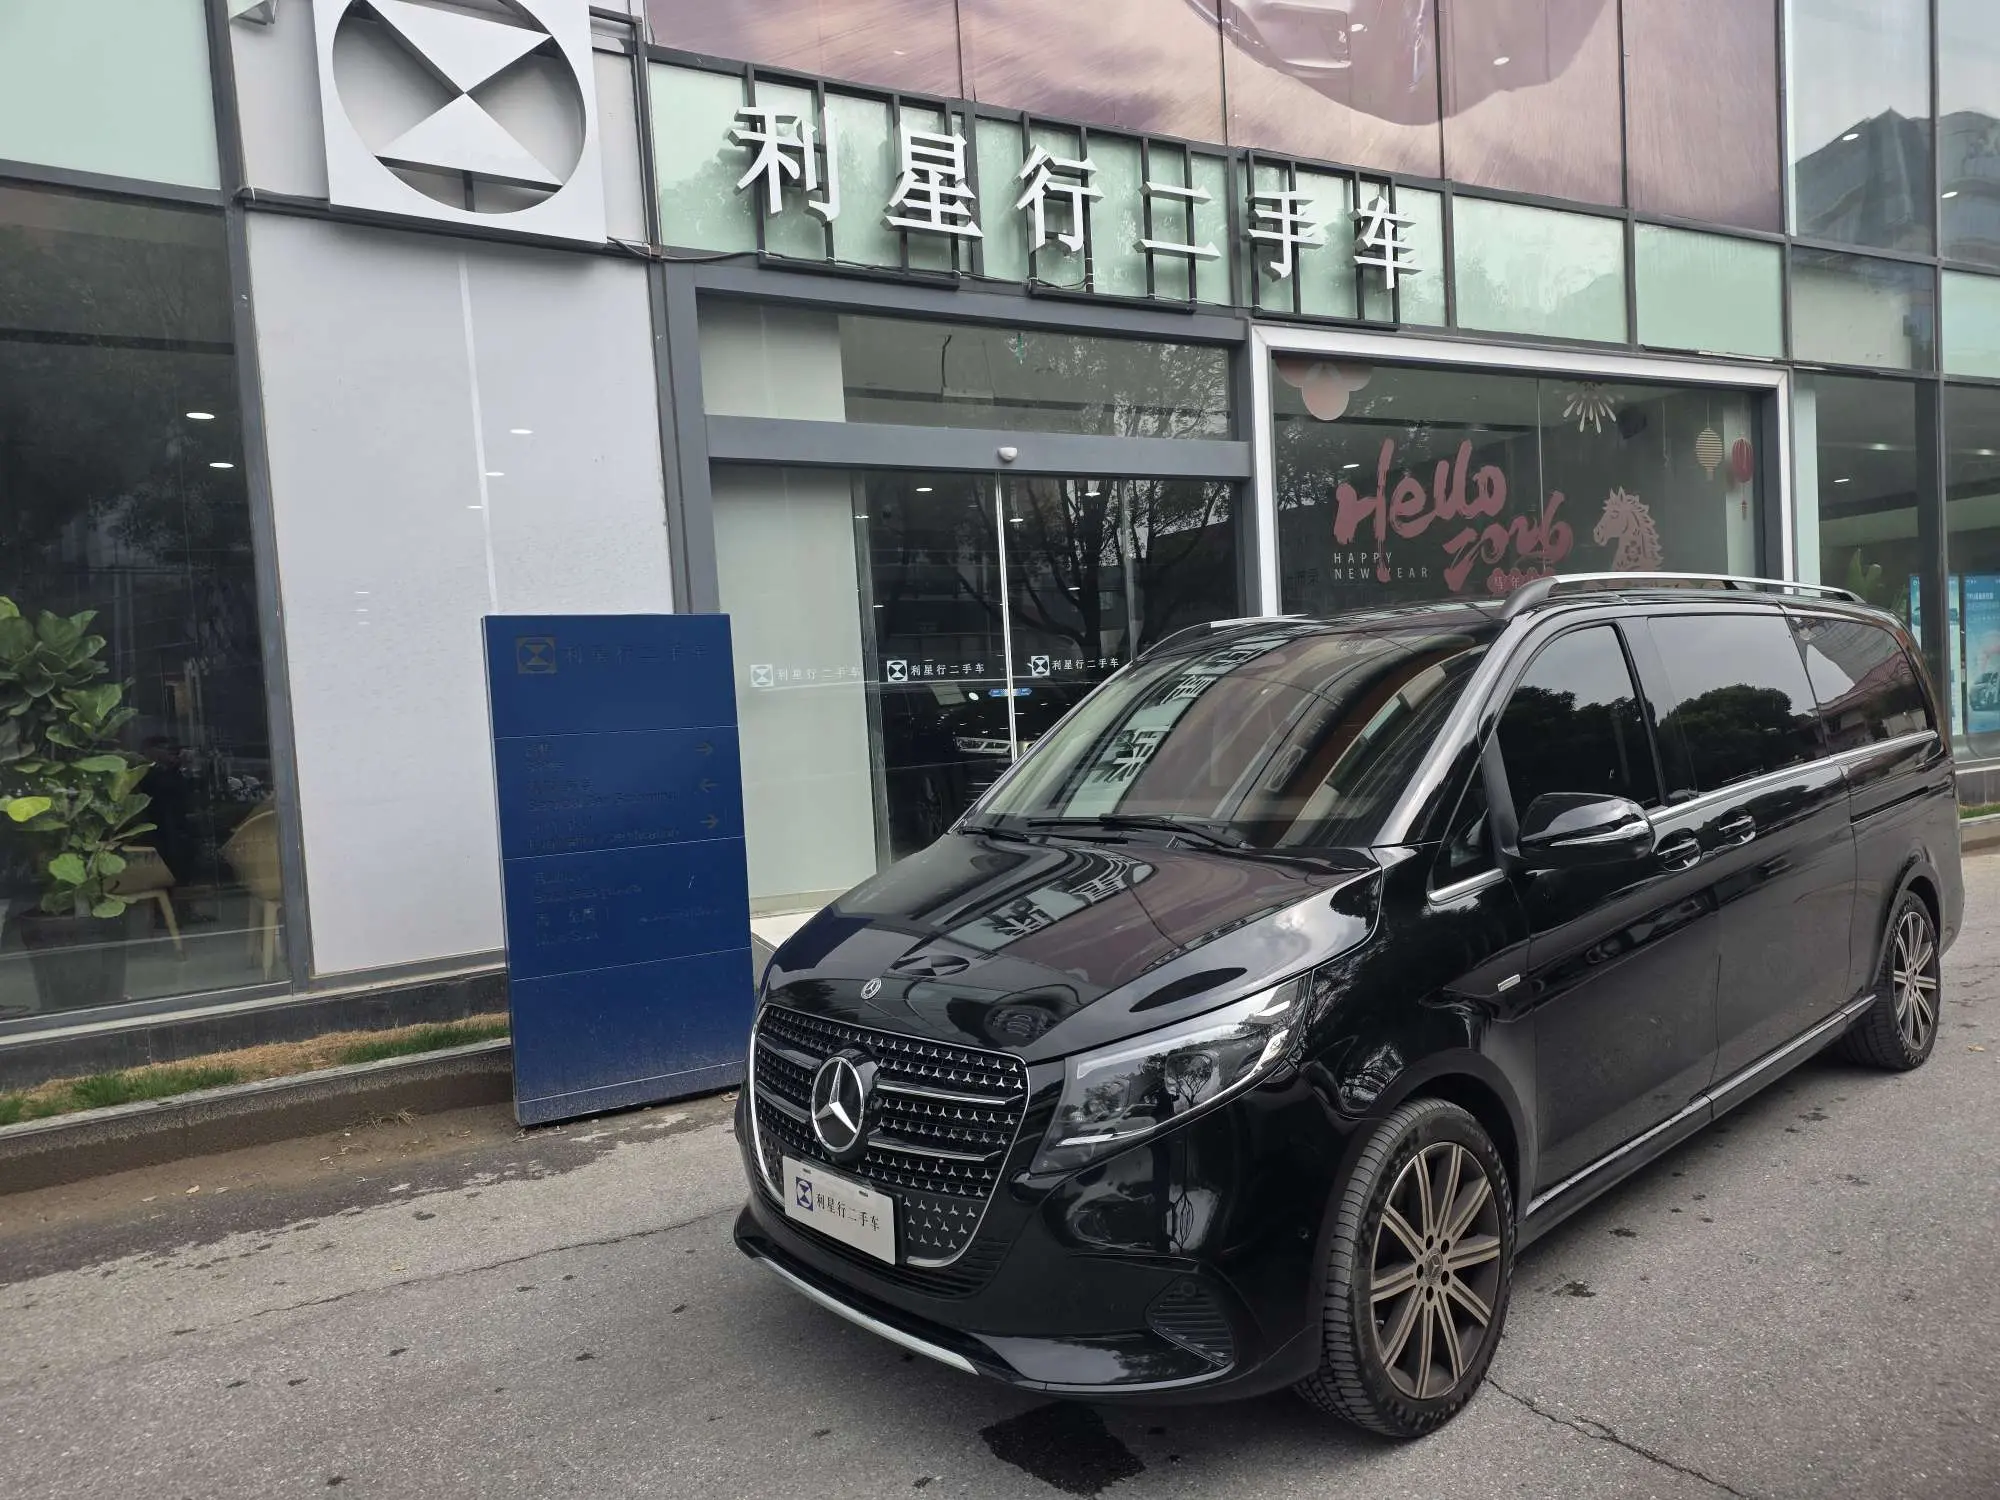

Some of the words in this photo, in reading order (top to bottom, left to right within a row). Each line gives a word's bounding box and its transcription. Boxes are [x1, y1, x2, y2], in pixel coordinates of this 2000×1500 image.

[728, 104, 1422, 290] 利星行二手车
[1333, 438, 1507, 545] Hello
[1333, 552, 1393, 565] HAPPY
[1334, 567, 1370, 580] NEW
[1383, 566, 1428, 579] YEAR
[910, 662, 986, 677] 利星行二手车
[1050, 656, 1121, 671] 利星行二手车
[815, 1193, 880, 1232] 利星行二手车
